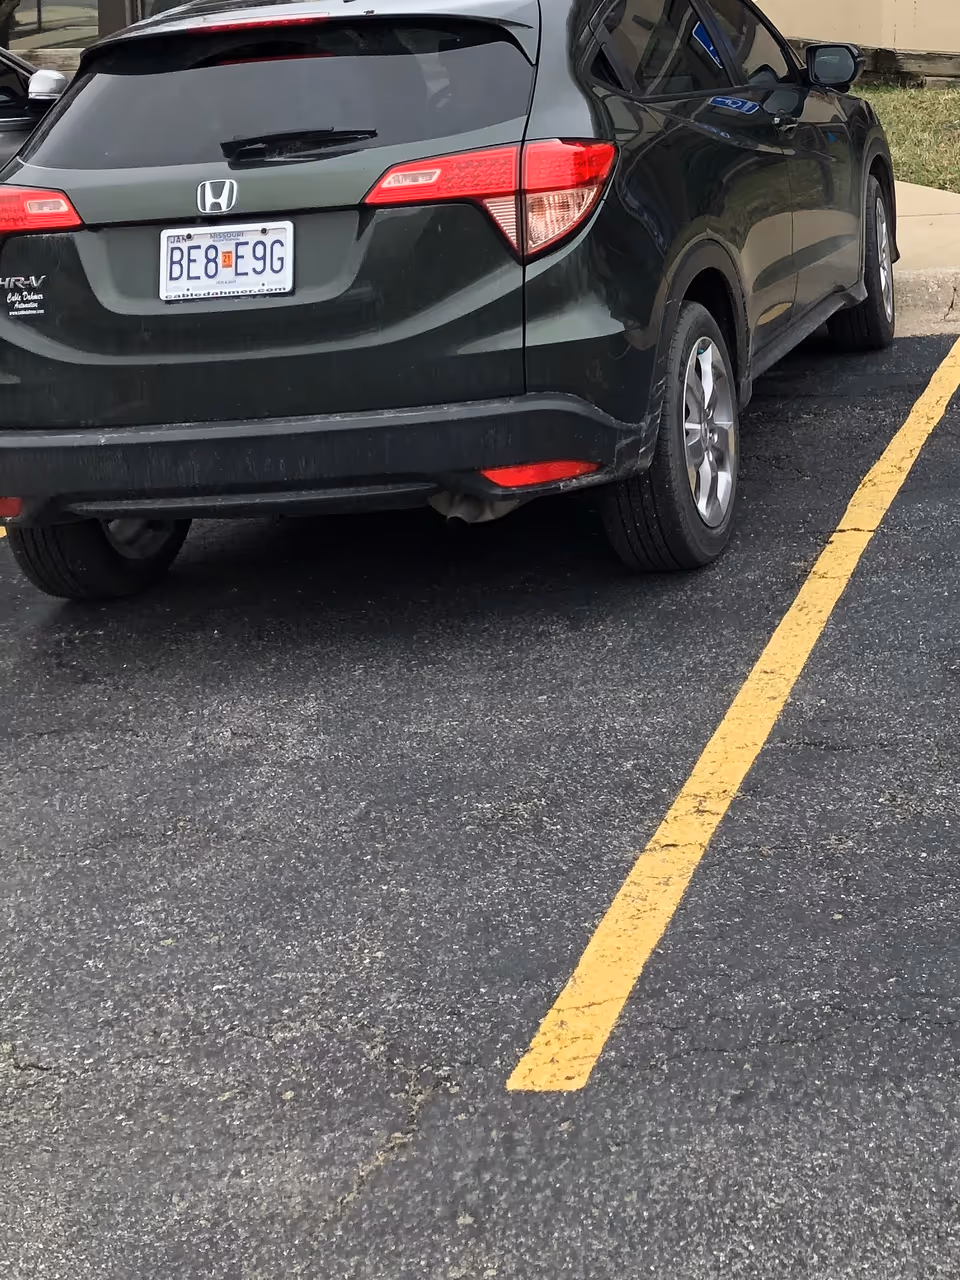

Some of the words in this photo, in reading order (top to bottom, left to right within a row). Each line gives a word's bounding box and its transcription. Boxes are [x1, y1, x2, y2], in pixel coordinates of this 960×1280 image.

[170, 236, 187, 244] JAN
[209, 232, 244, 240] MISSOURI
[169, 244, 219, 281] BE8
[234, 239, 285, 276] E9G
[165, 287, 287, 300] cabledahmer.com
